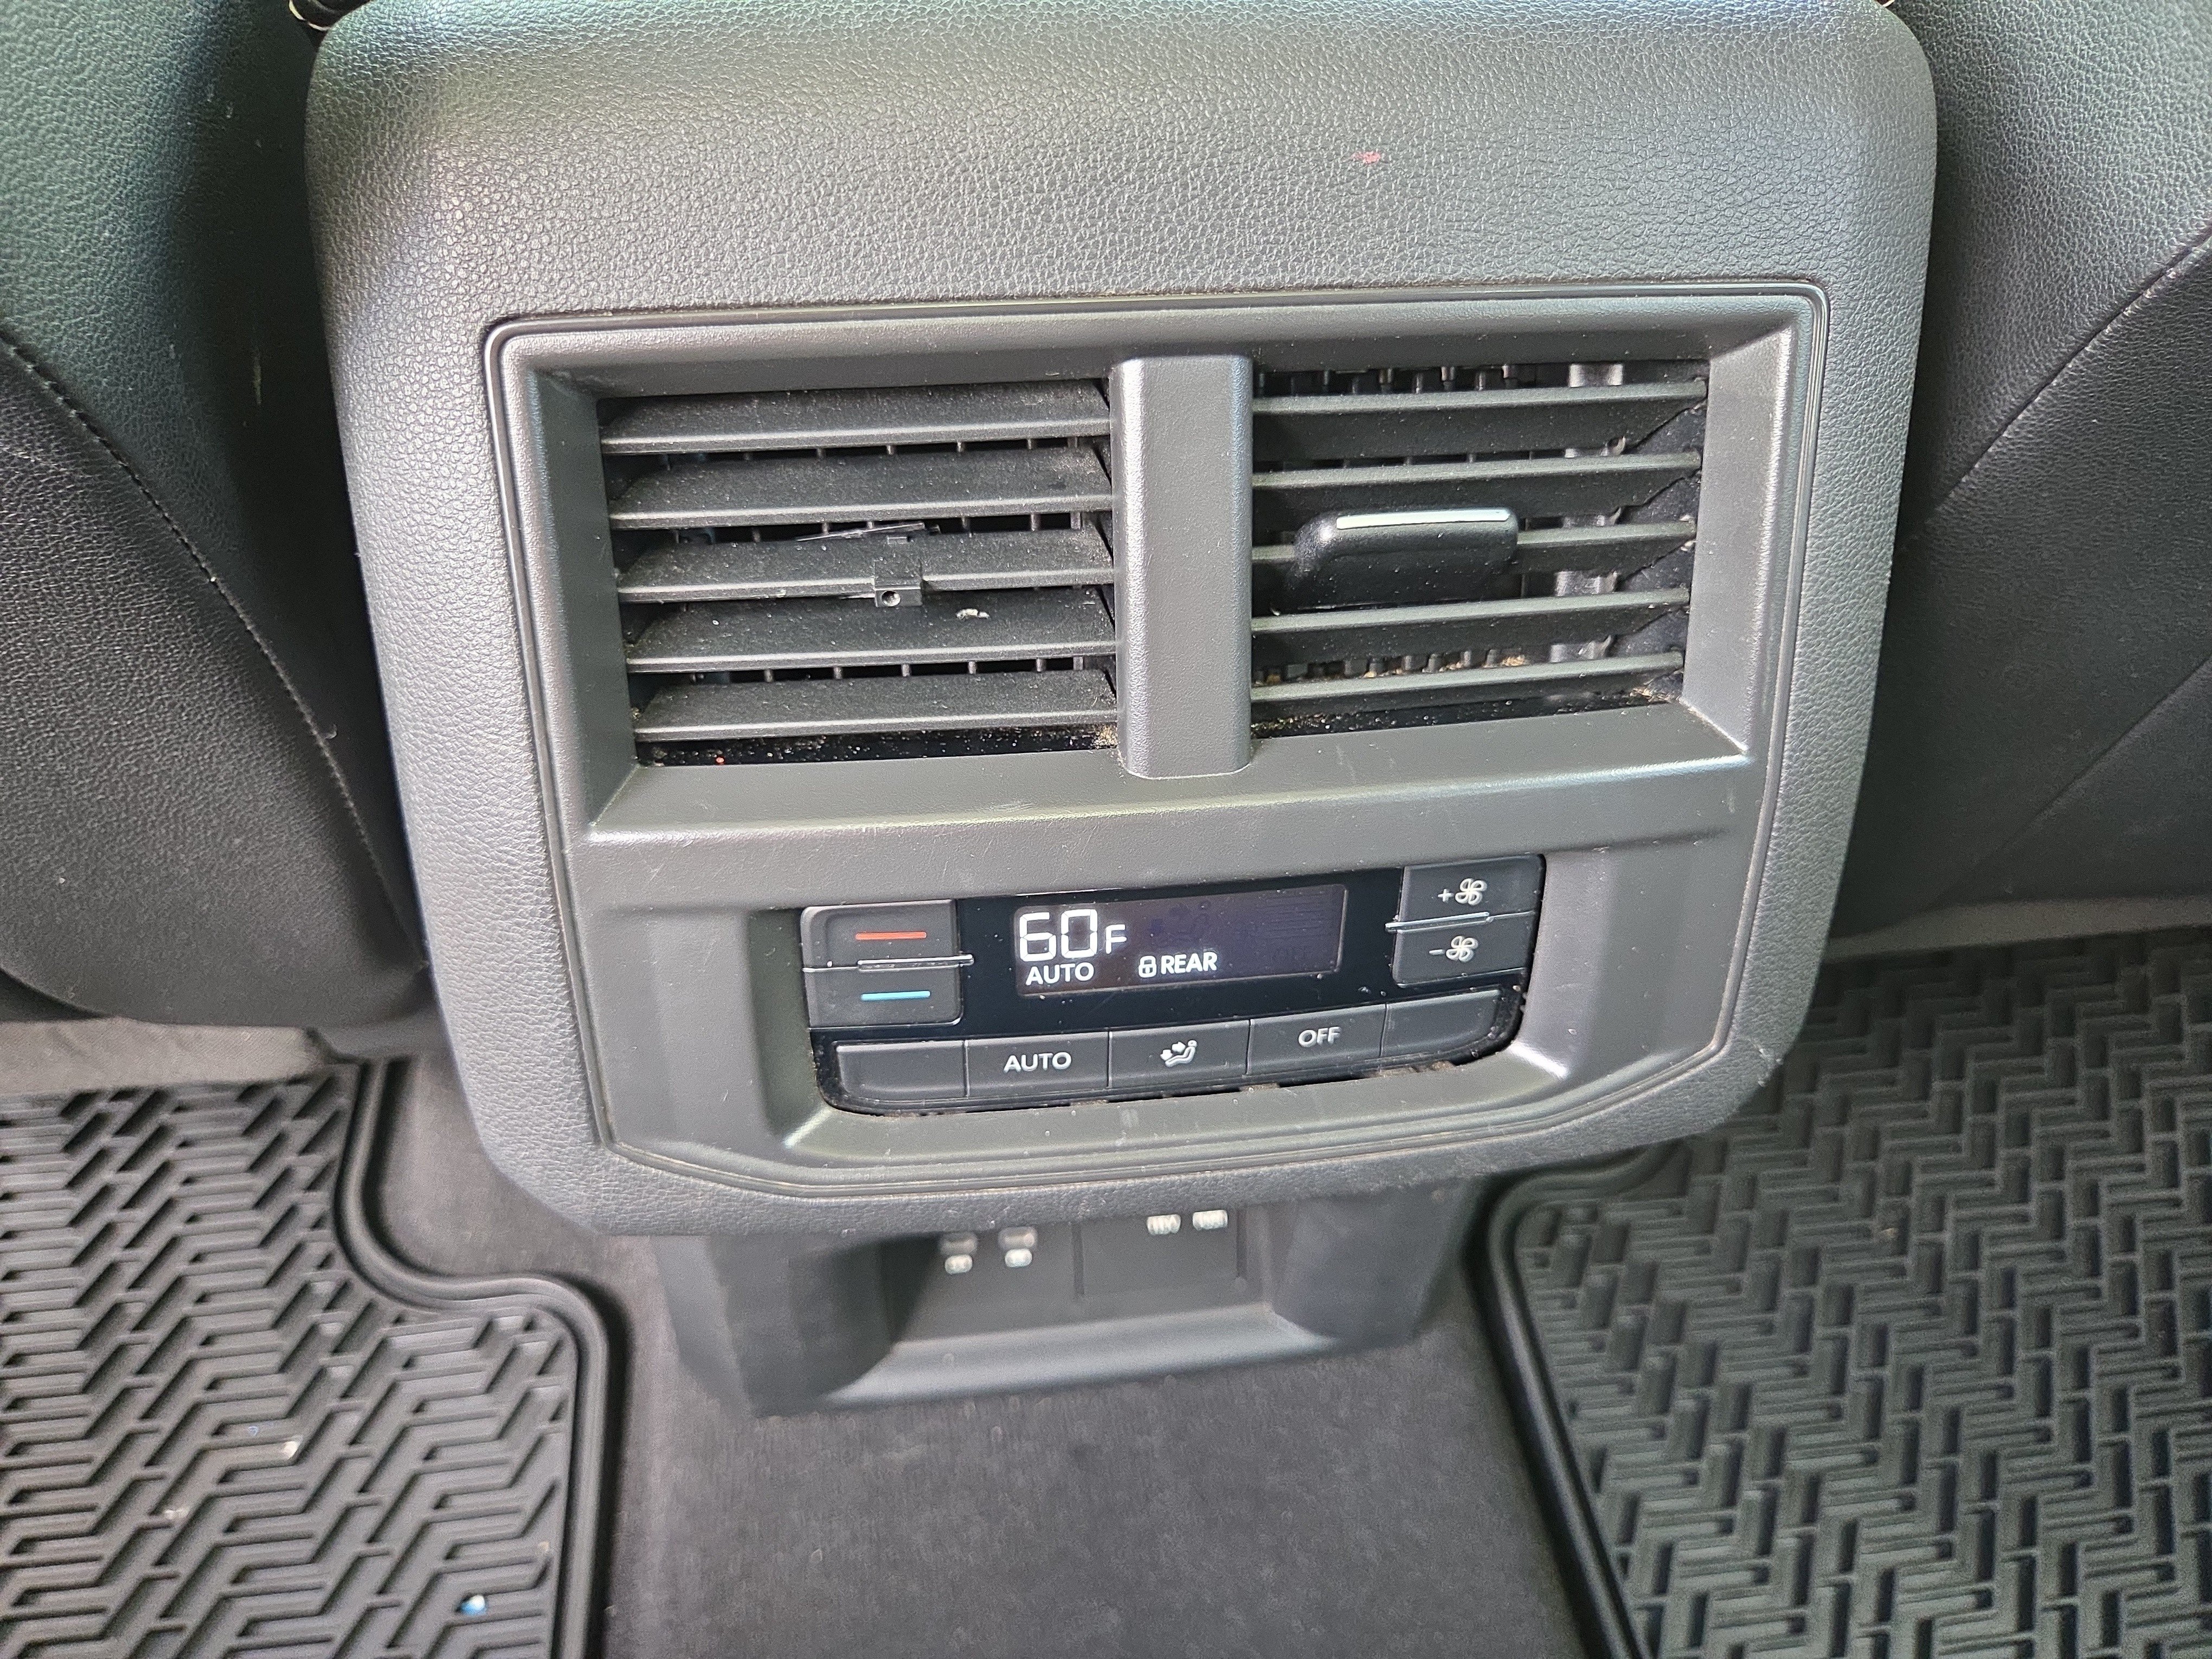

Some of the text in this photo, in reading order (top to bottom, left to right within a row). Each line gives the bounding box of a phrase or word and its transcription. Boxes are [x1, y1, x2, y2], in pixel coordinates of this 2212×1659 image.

[1025, 962, 1094, 986] AUTO
[1160, 951, 1218, 975] REAR
[1298, 1026, 1341, 1047] OFF
[1003, 1051, 1072, 1073] AUTO
